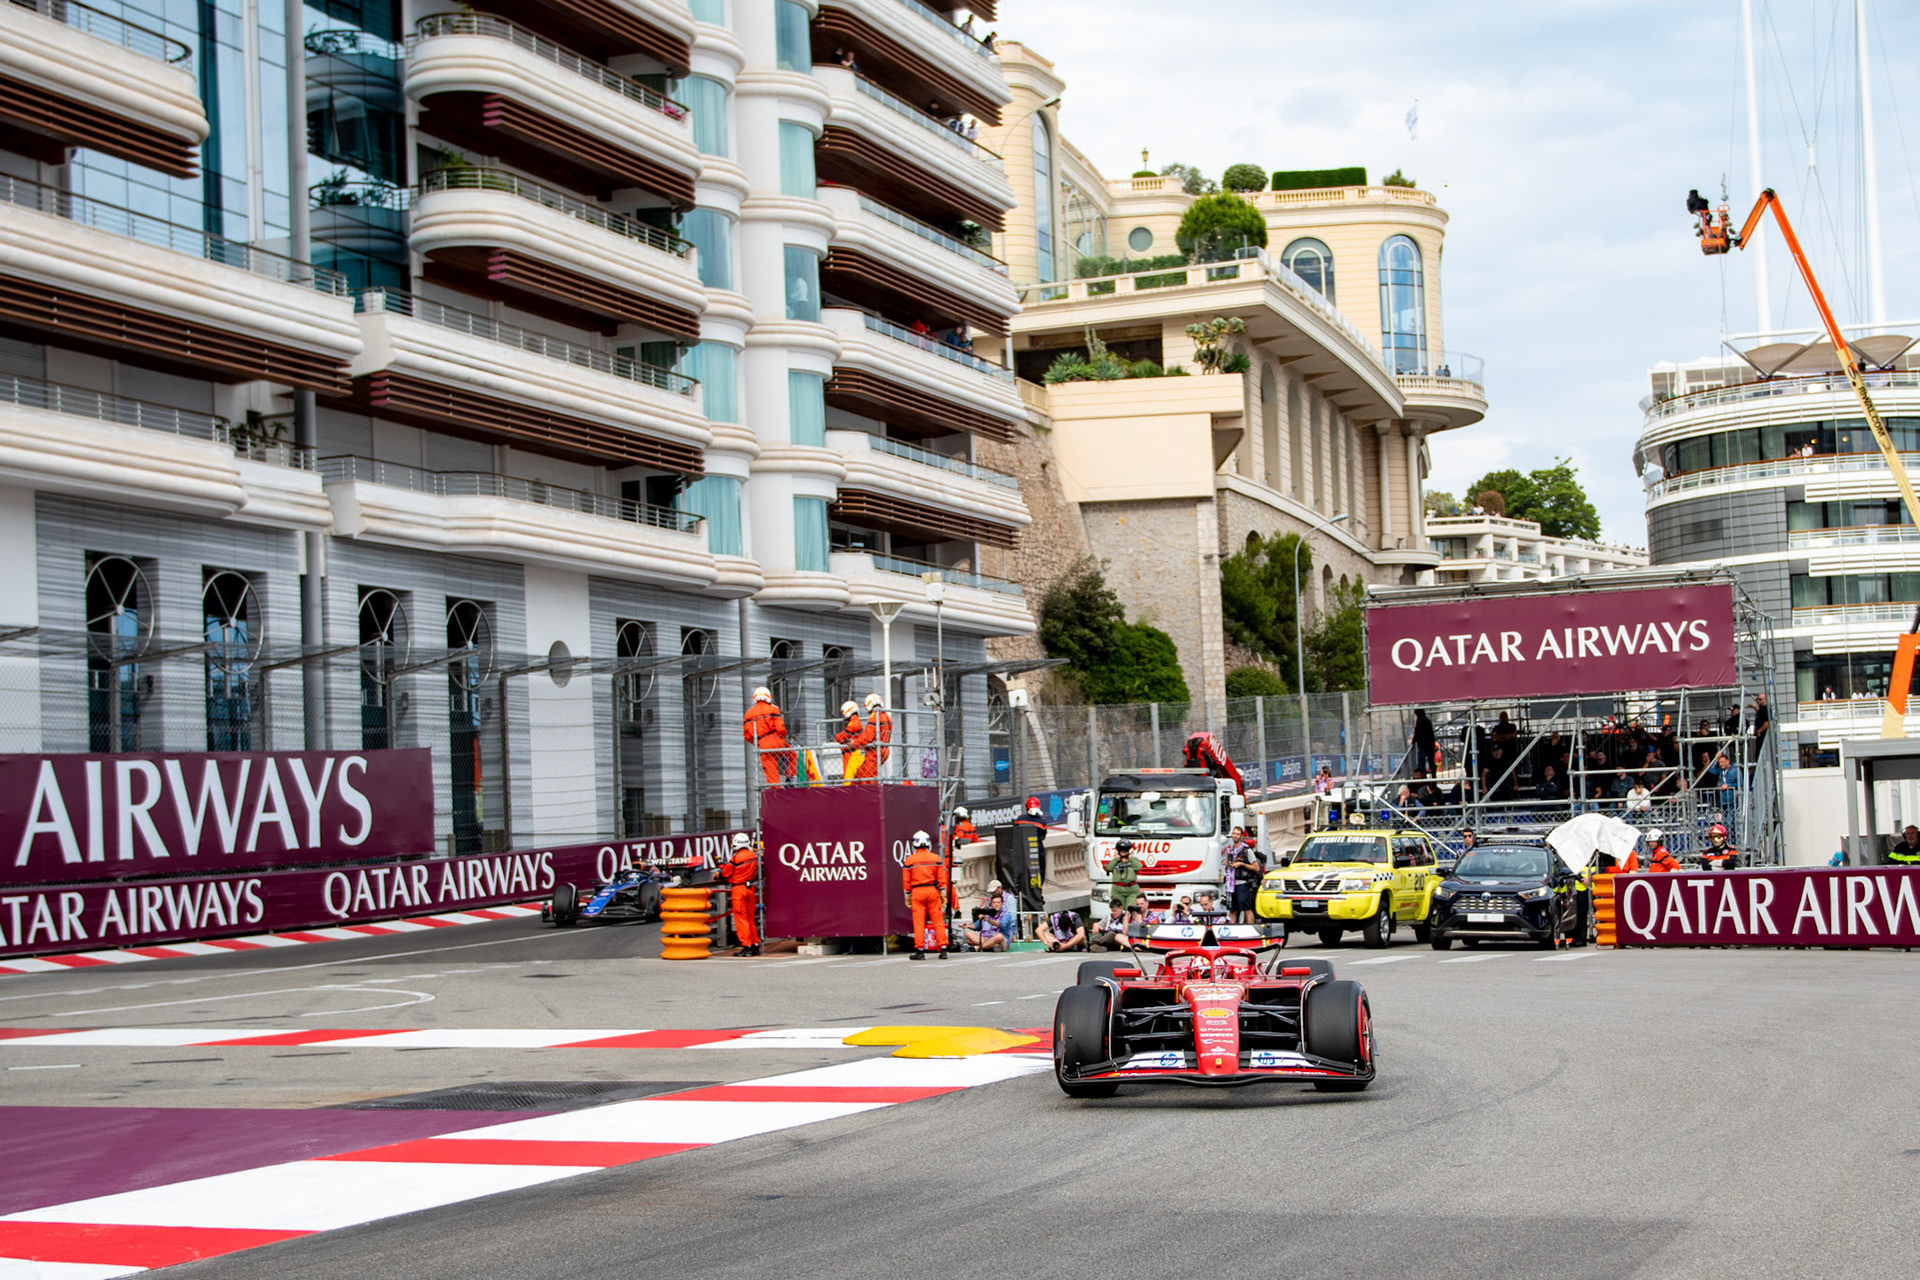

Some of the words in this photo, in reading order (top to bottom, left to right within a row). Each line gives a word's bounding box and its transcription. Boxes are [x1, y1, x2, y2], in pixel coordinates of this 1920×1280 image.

[1859, 386, 1885, 436] RIWAL.COM
[1391, 631, 1525, 671] QATAR
[1536, 619, 1710, 660] AIRWAYS
[15, 755, 373, 867] AIRWAYS
[971, 804, 1022, 827] #MonacoG
[779, 841, 866, 871] QATAR
[800, 865, 867, 882] AIRWAYS
[324, 864, 432, 918] QATAR
[439, 852, 555, 902] AIRWAYS
[1623, 877, 1779, 940] QATAR
[0, 891, 89, 947] TAR
[99, 879, 264, 938] AIRWAYS
[1181, 926, 1194, 938] hp
[1218, 926, 1230, 938] hp
